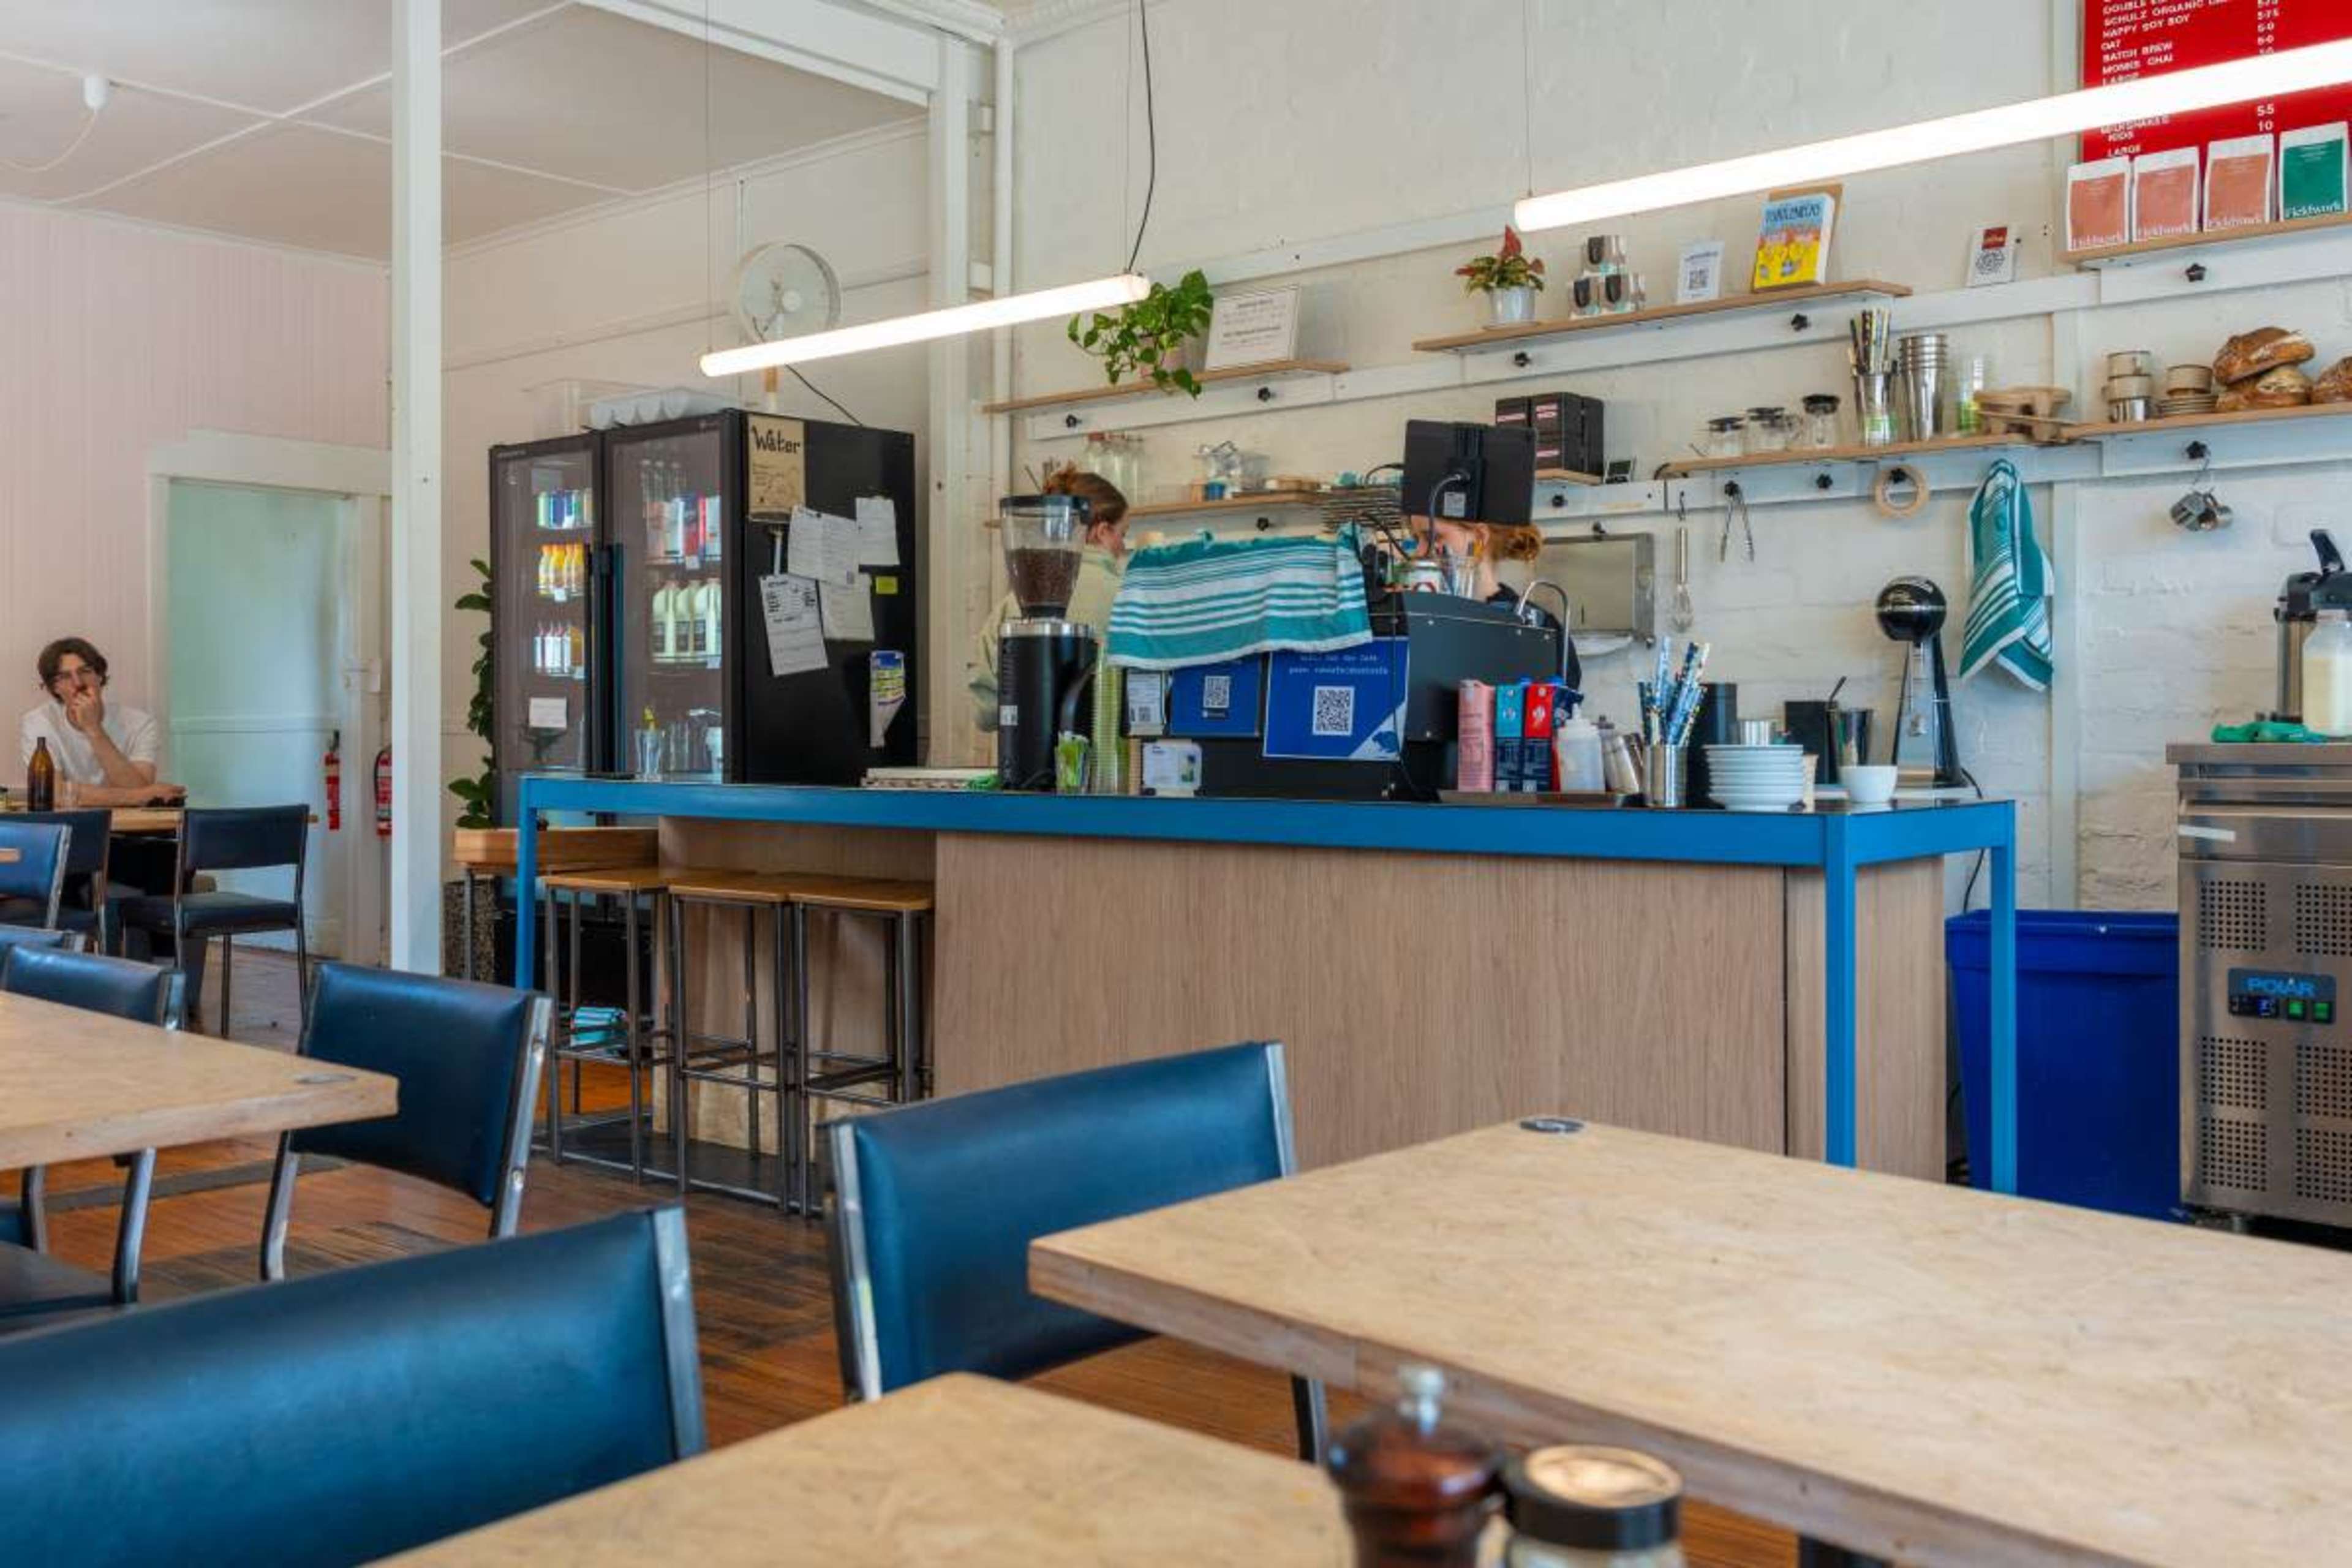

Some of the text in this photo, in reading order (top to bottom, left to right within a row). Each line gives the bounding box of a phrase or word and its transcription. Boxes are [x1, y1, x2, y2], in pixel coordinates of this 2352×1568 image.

[2103, 10, 2147, 26] SCHULZ
[2102, 24, 2137, 39] HAPPY
[2141, 19, 2165, 32] SOY
[2101, 39, 2121, 51] OAT
[2102, 41, 2173, 63] BATCH BREW
[2147, 54, 2173, 66] CHAI
[2258, 120, 2273, 132] 10
[752, 424, 801, 454] Water
